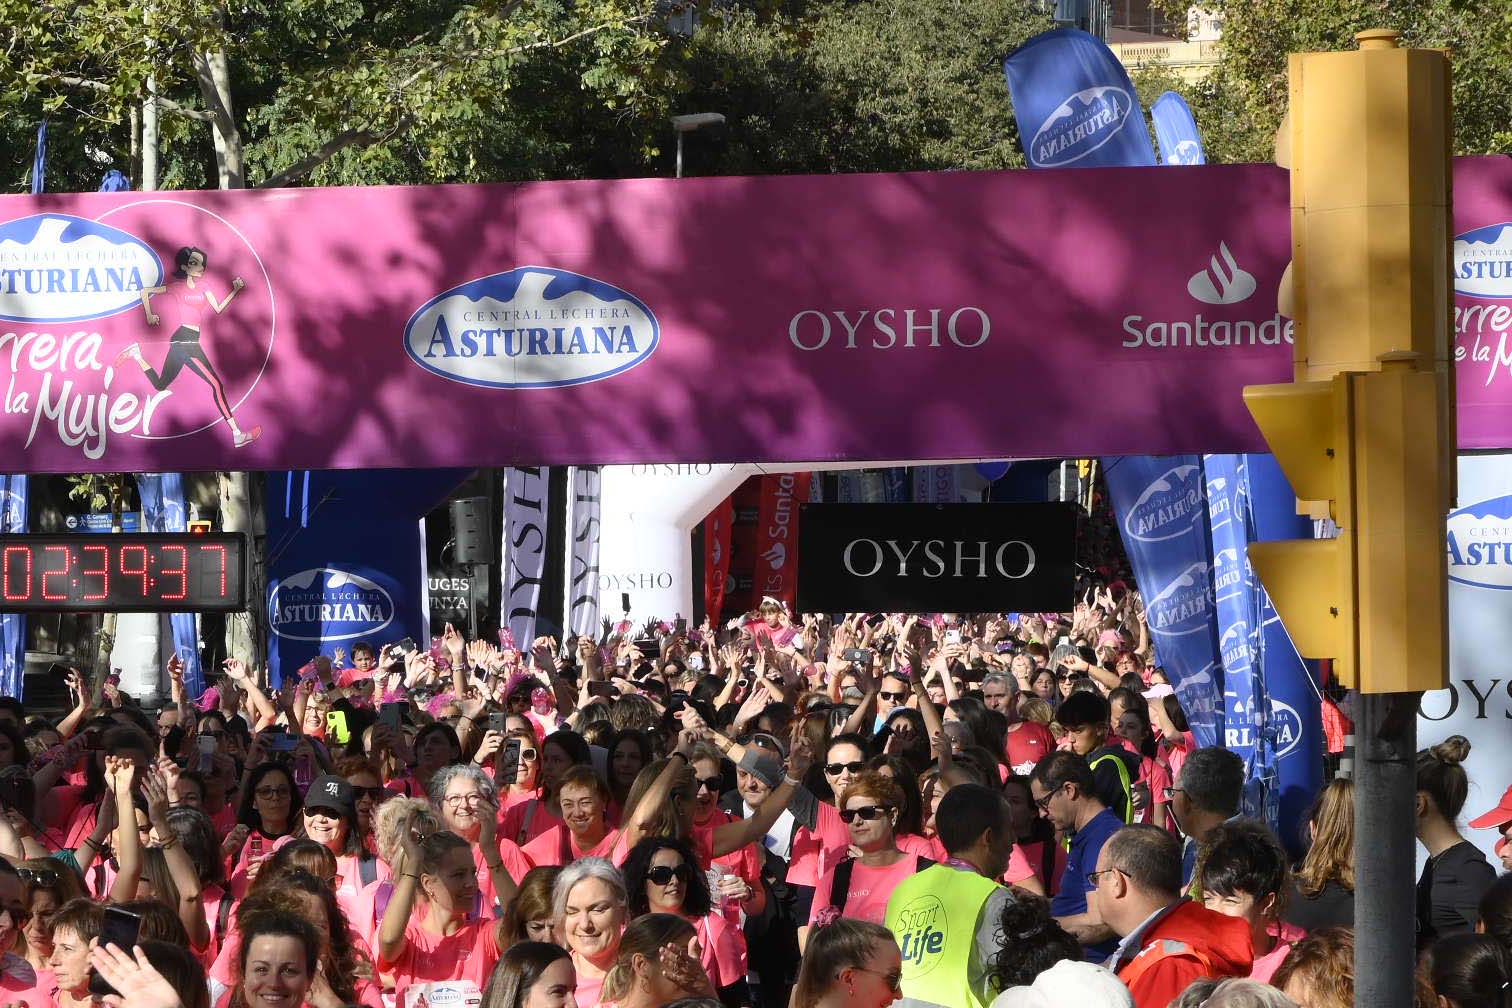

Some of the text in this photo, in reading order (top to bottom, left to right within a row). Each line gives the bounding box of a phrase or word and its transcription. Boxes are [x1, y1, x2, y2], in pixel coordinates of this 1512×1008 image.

[67, 250, 138, 261] LECHERA
[464, 307, 630, 322] CENTRAL LECHERA
[788, 306, 991, 351] OYSHO
[1122, 313, 1294, 348] Santande
[425, 313, 640, 358] ASTURIANA
[1473, 335, 1489, 362] la
[5, 373, 29, 415] la
[24, 368, 172, 460] Mujer
[2, 546, 226, 600] 02:39:37
[843, 538, 1037, 579] OYSHO
[599, 571, 673, 591] OYSHO
[273, 603, 385, 626] ASTURIANA
[896, 904, 940, 933] Sport
[901, 923, 944, 966] Life
